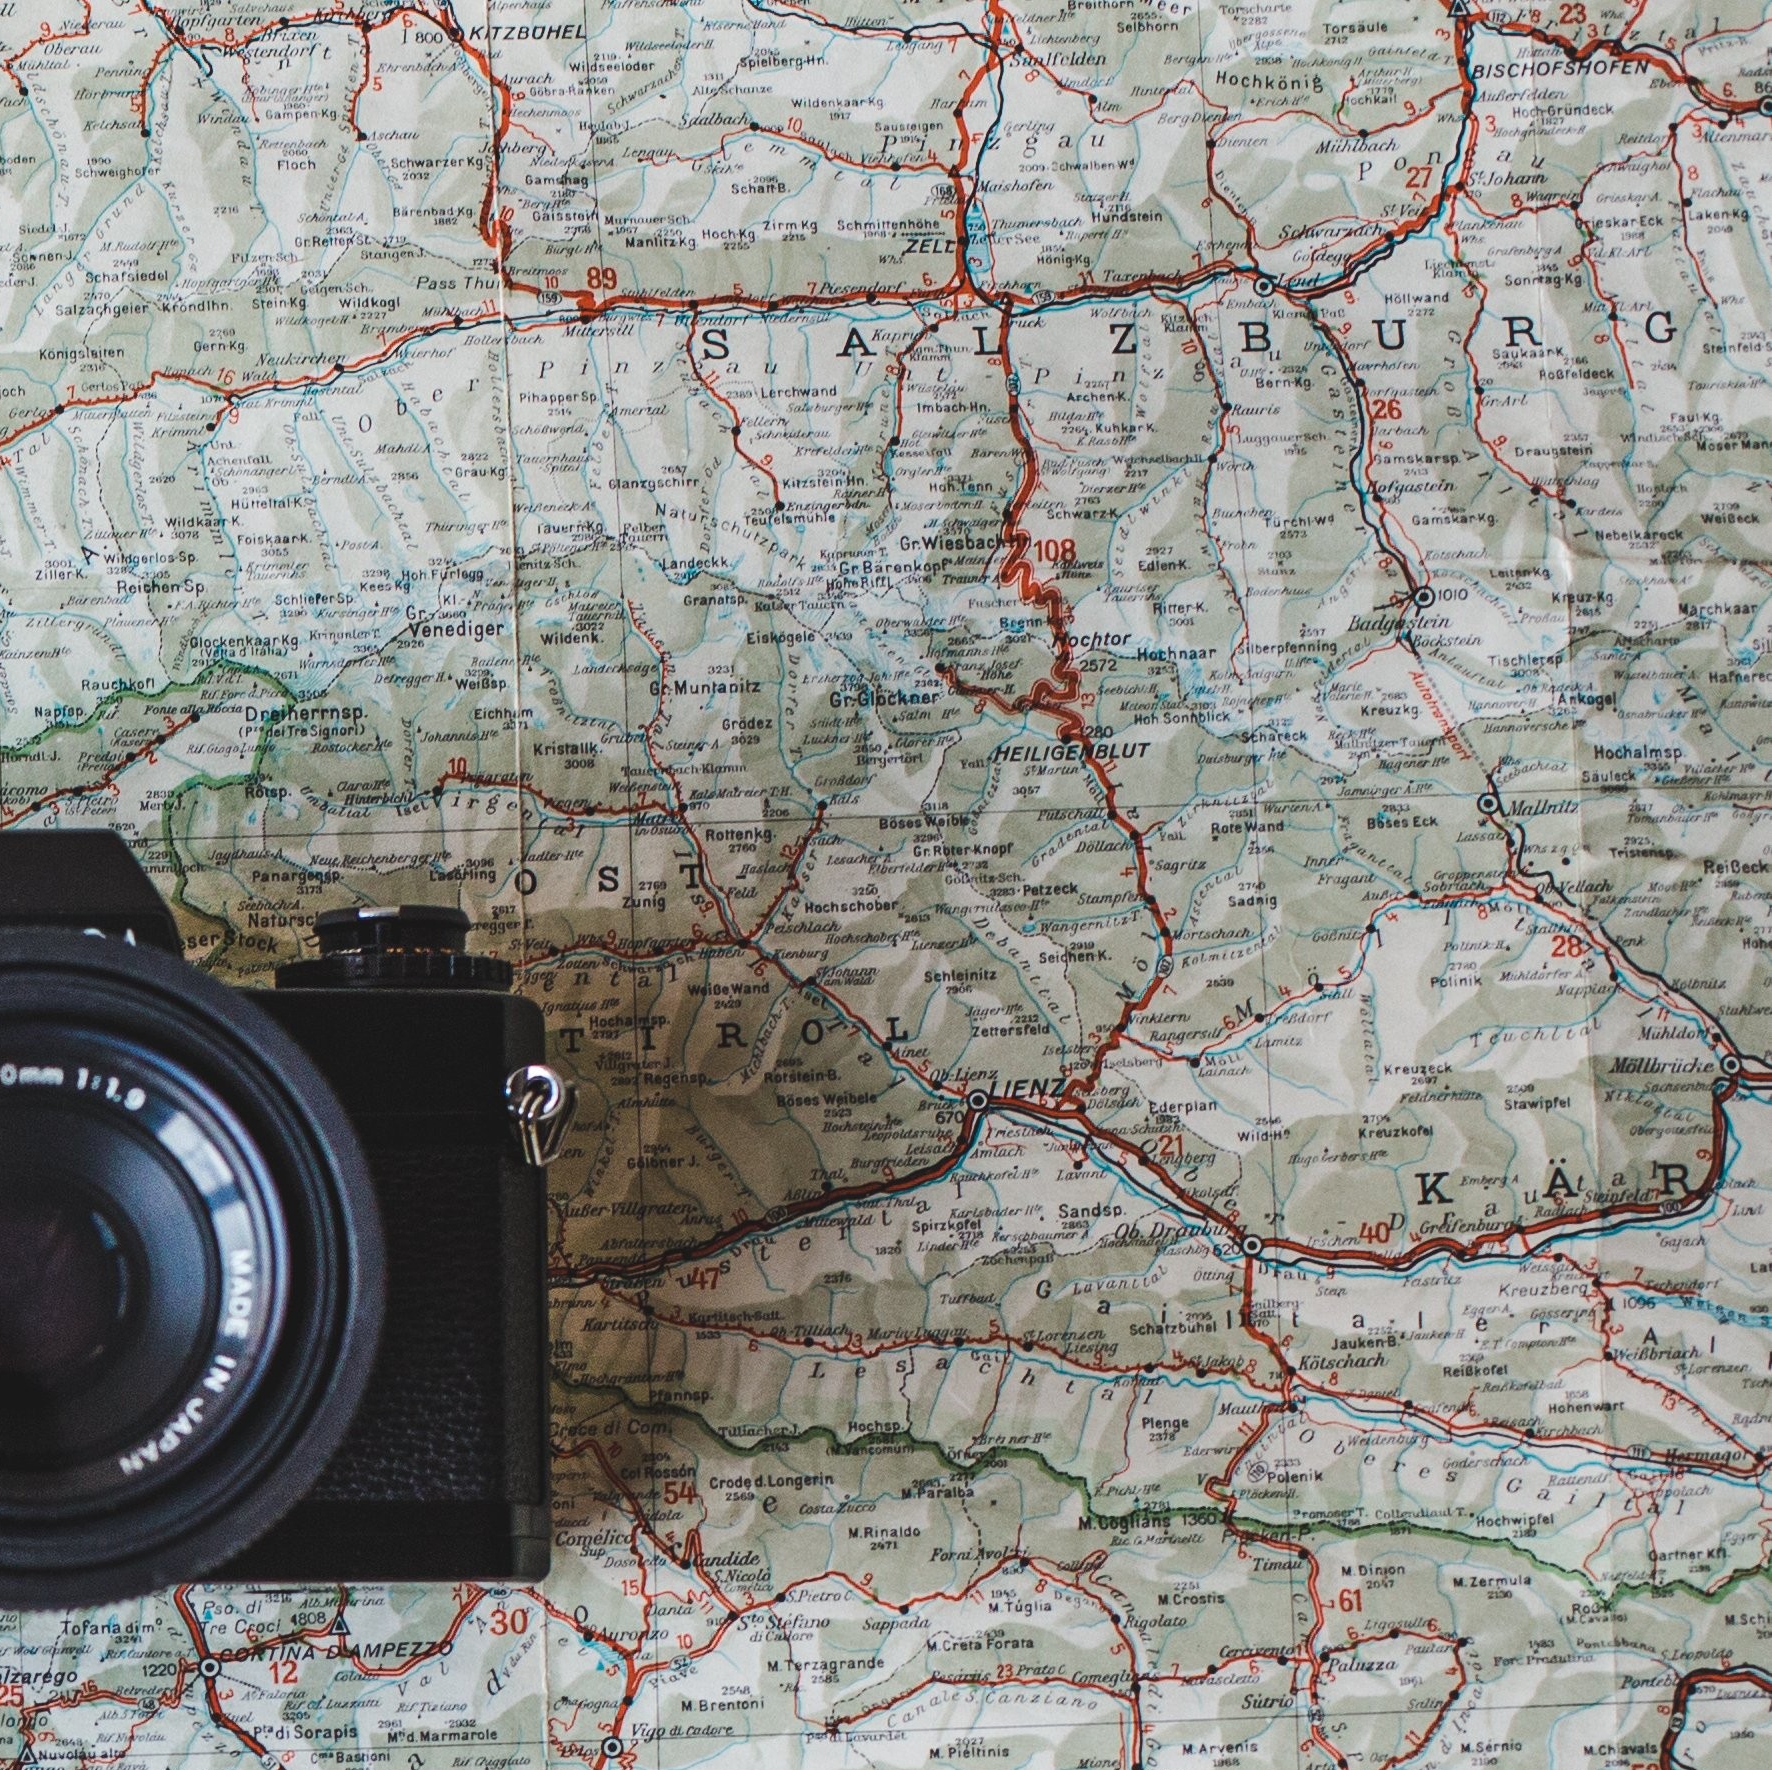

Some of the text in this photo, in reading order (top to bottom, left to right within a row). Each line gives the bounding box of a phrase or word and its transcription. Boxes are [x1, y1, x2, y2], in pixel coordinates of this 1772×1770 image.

[1560, 3, 1586, 24] 23
[470, 22, 587, 41] KITZBÜHEL
[1470, 58, 1650, 80] BISCHOFSHOFEN
[1217, 71, 1323, 93] Hochkönig
[1315, 136, 1397, 154] Mühlbach
[1092, 209, 1162, 223] Hundstein
[587, 267, 617, 290] 89
[339, 297, 399, 311] Wildkogl
[1385, 292, 1449, 304] Höllwand
[256, 351, 341, 368] Neukirchen
[761, 386, 836, 398] Lerchwand
[1371, 399, 1402, 423] 26
[992, 741, 1150, 764] HEILIGENBLUT
[1613, 1057, 1714, 1074] Möllbrücke
[77, 1067, 146, 1110] 1:1.9
[987, 1075, 1067, 1101] LIENZ
[1059, 1202, 1126, 1218] Sandsp.
[119, 1250, 253, 1476] MADE IN JAPAN
[1299, 1353, 1387, 1374] Kötschach
[491, 1608, 528, 1635] 30
[863, 1614, 930, 1634] Sappada
[218, 1642, 315, 1664] CORTINA
[143, 1661, 179, 1677] 1220
